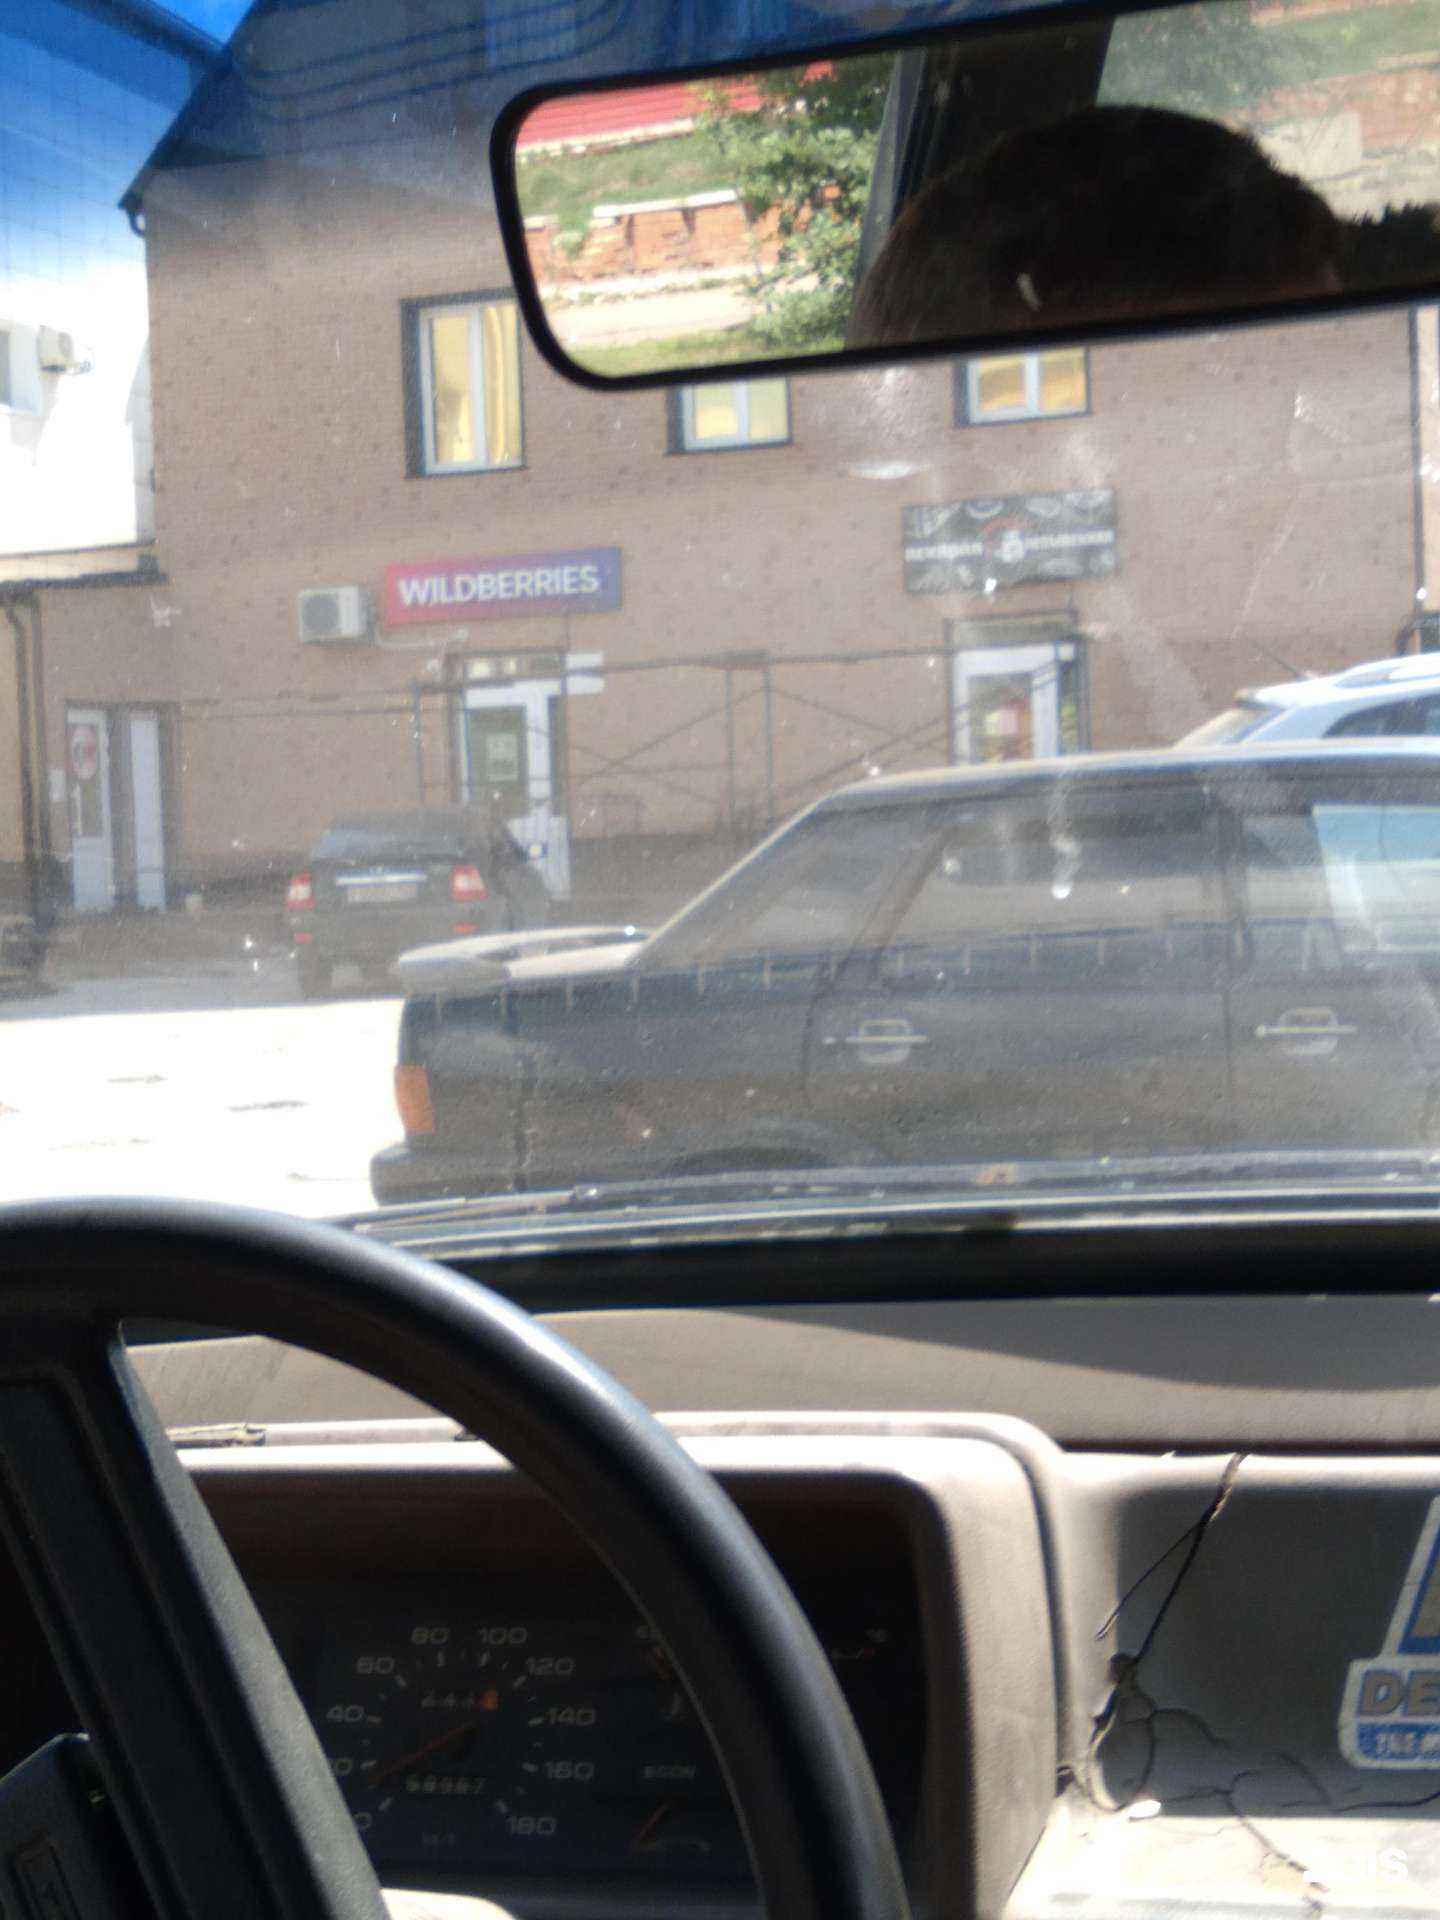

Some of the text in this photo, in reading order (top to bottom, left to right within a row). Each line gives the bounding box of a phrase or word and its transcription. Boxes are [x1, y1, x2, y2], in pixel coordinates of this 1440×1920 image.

[397, 565, 599, 608] WILDBERRIES
[410, 1626, 450, 1645] 80
[476, 1626, 529, 1645] 100
[355, 1655, 396, 1675] 60
[524, 1655, 577, 1676] 120
[325, 1704, 365, 1724] 40
[545, 1706, 597, 1727] 140
[543, 1760, 596, 1782] 160
[504, 1815, 559, 1836] 180
